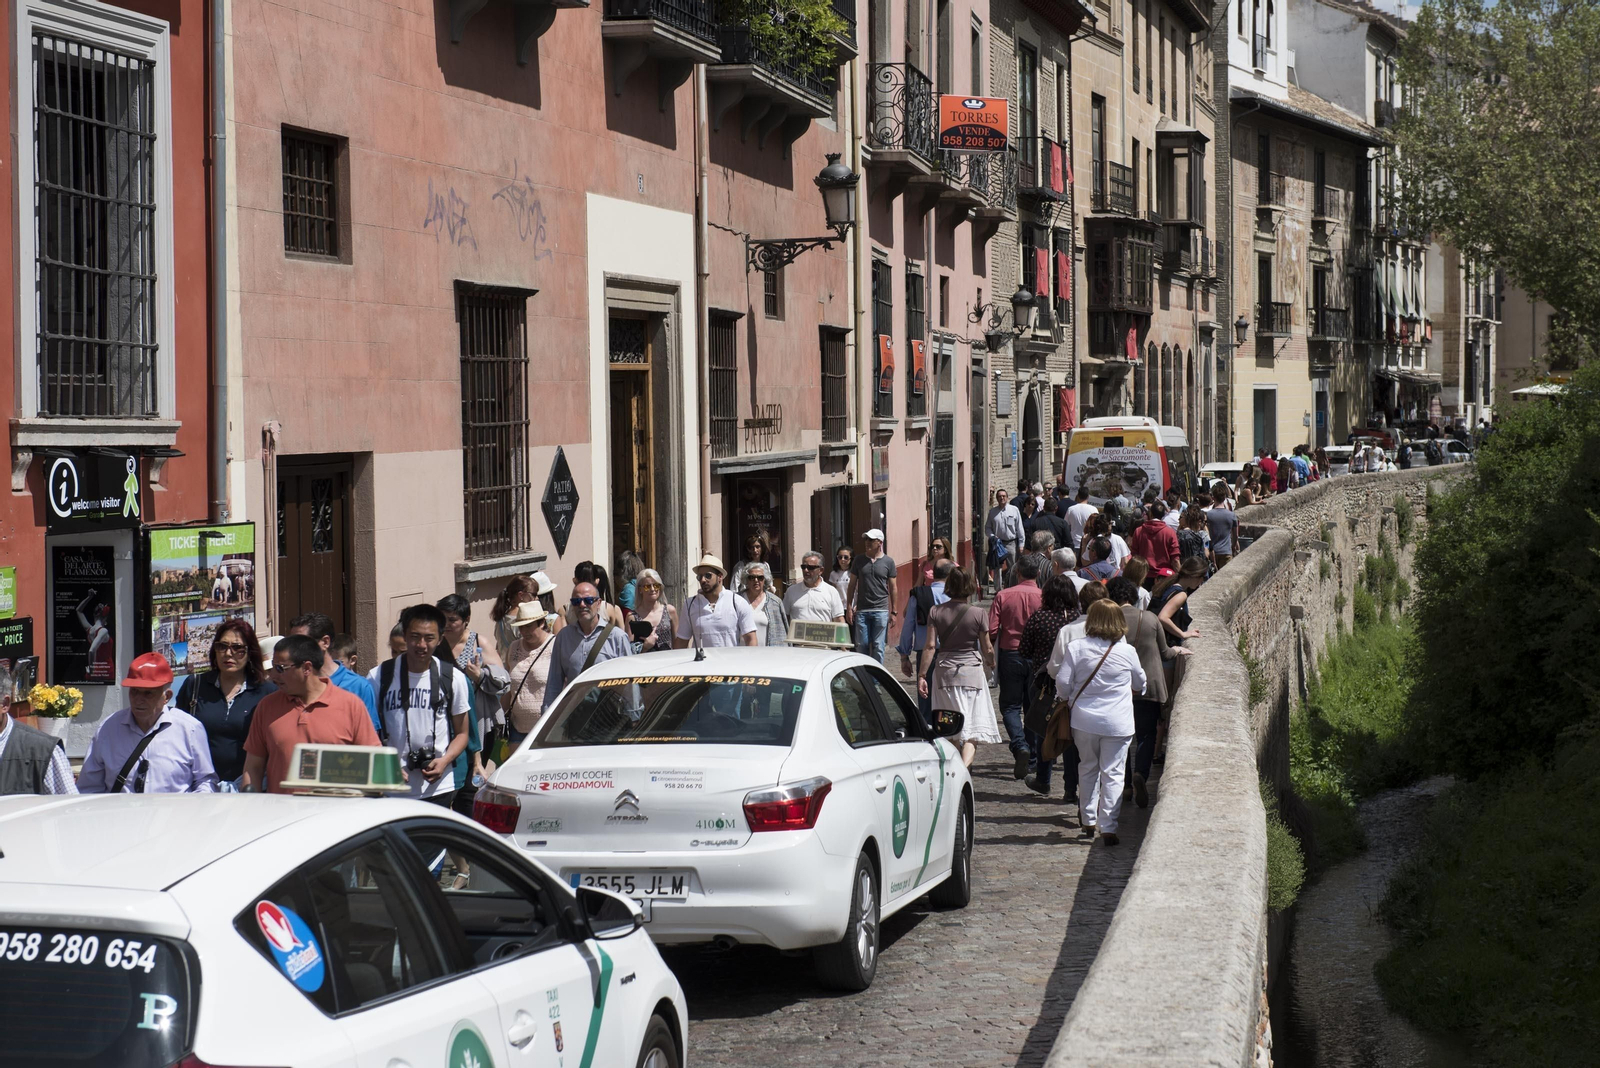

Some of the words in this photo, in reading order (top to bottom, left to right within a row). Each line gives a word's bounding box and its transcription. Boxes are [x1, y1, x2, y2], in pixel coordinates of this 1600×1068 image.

[950, 111, 998, 124] TORRES
[958, 126, 990, 136] VENDE
[943, 136, 962, 145] 958
[965, 136, 984, 146] 208
[987, 138, 1006, 148] 507
[554, 480, 572, 493] PATIO
[72, 499, 100, 510] welcome
[100, 496, 120, 508] visitor
[4, 633, 23, 645] PRICE
[598, 679, 629, 688] RADIO
[632, 676, 655, 684] TAXI
[791, 685, 802, 694] P
[540, 772, 568, 781] REVISO
[582, 771, 613, 779] COCHE
[552, 781, 614, 790] RONDAMOVIL
[645, 876, 684, 895] JLM
[45, 933, 99, 965] 280
[105, 939, 157, 973] 654
[546, 988, 558, 1003] TAXI
[137, 993, 178, 1030] P
[549, 1004, 560, 1019] 422
